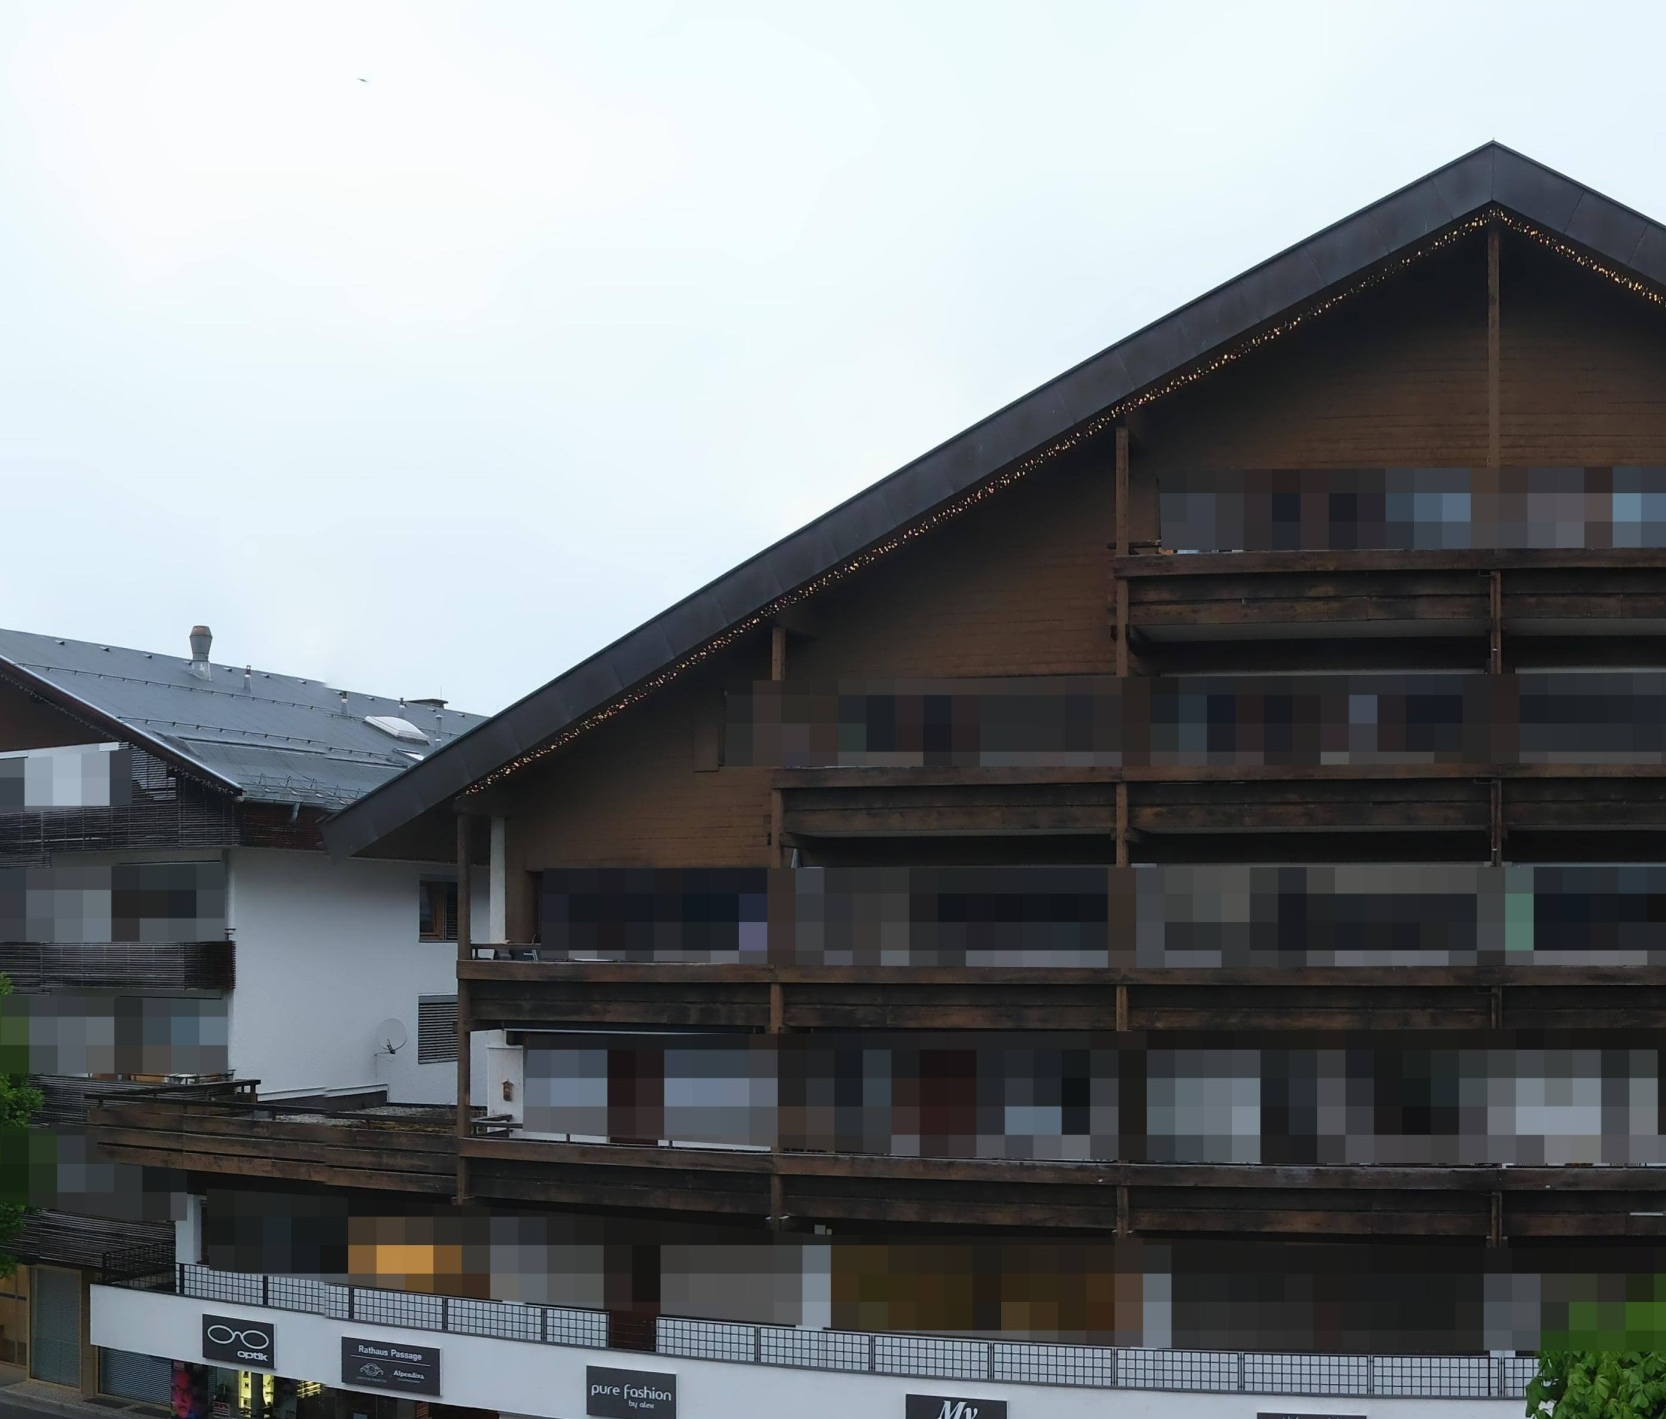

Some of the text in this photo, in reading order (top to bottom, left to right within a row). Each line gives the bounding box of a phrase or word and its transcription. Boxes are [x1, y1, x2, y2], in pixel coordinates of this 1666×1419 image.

[236, 1350, 269, 1362] optik
[358, 1344, 422, 1362] Rathaus Passage
[591, 1384, 672, 1401] pure fashion
[628, 1400, 638, 1409] by
